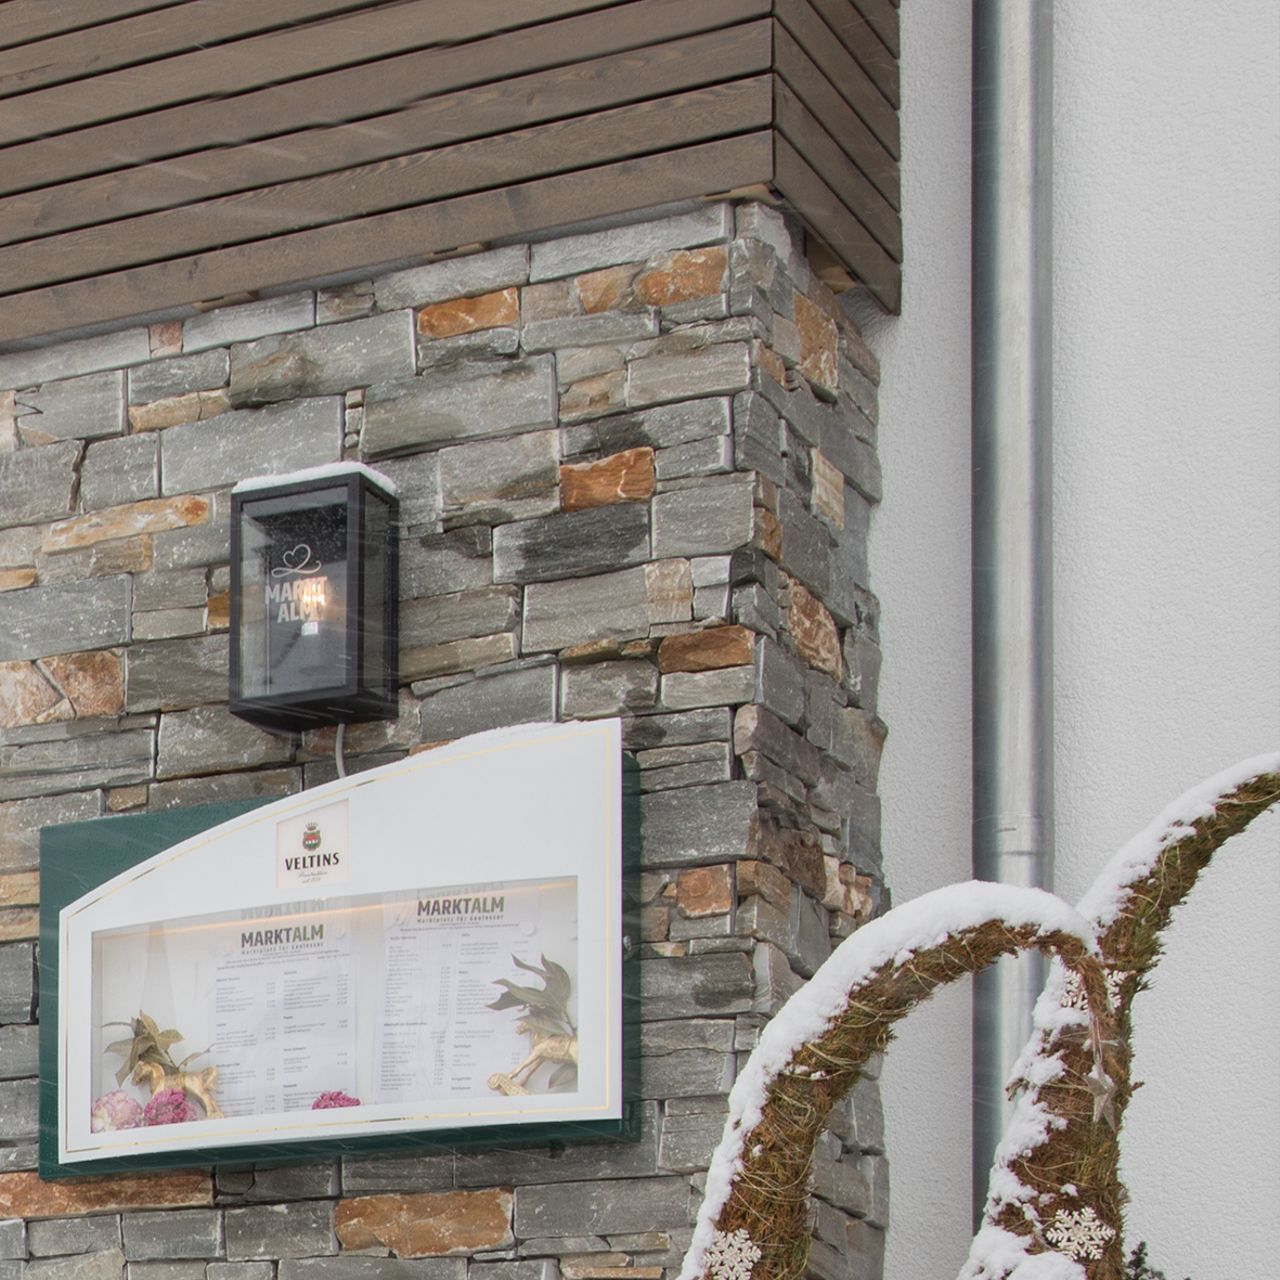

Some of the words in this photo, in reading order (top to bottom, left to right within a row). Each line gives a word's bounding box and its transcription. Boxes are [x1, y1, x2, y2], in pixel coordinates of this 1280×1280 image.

[265, 576, 328, 605] MARKT
[277, 601, 320, 624] ALM
[285, 852, 340, 871] VELTINS
[417, 896, 505, 917] MARKTALM
[241, 924, 324, 948] MARKTALM
